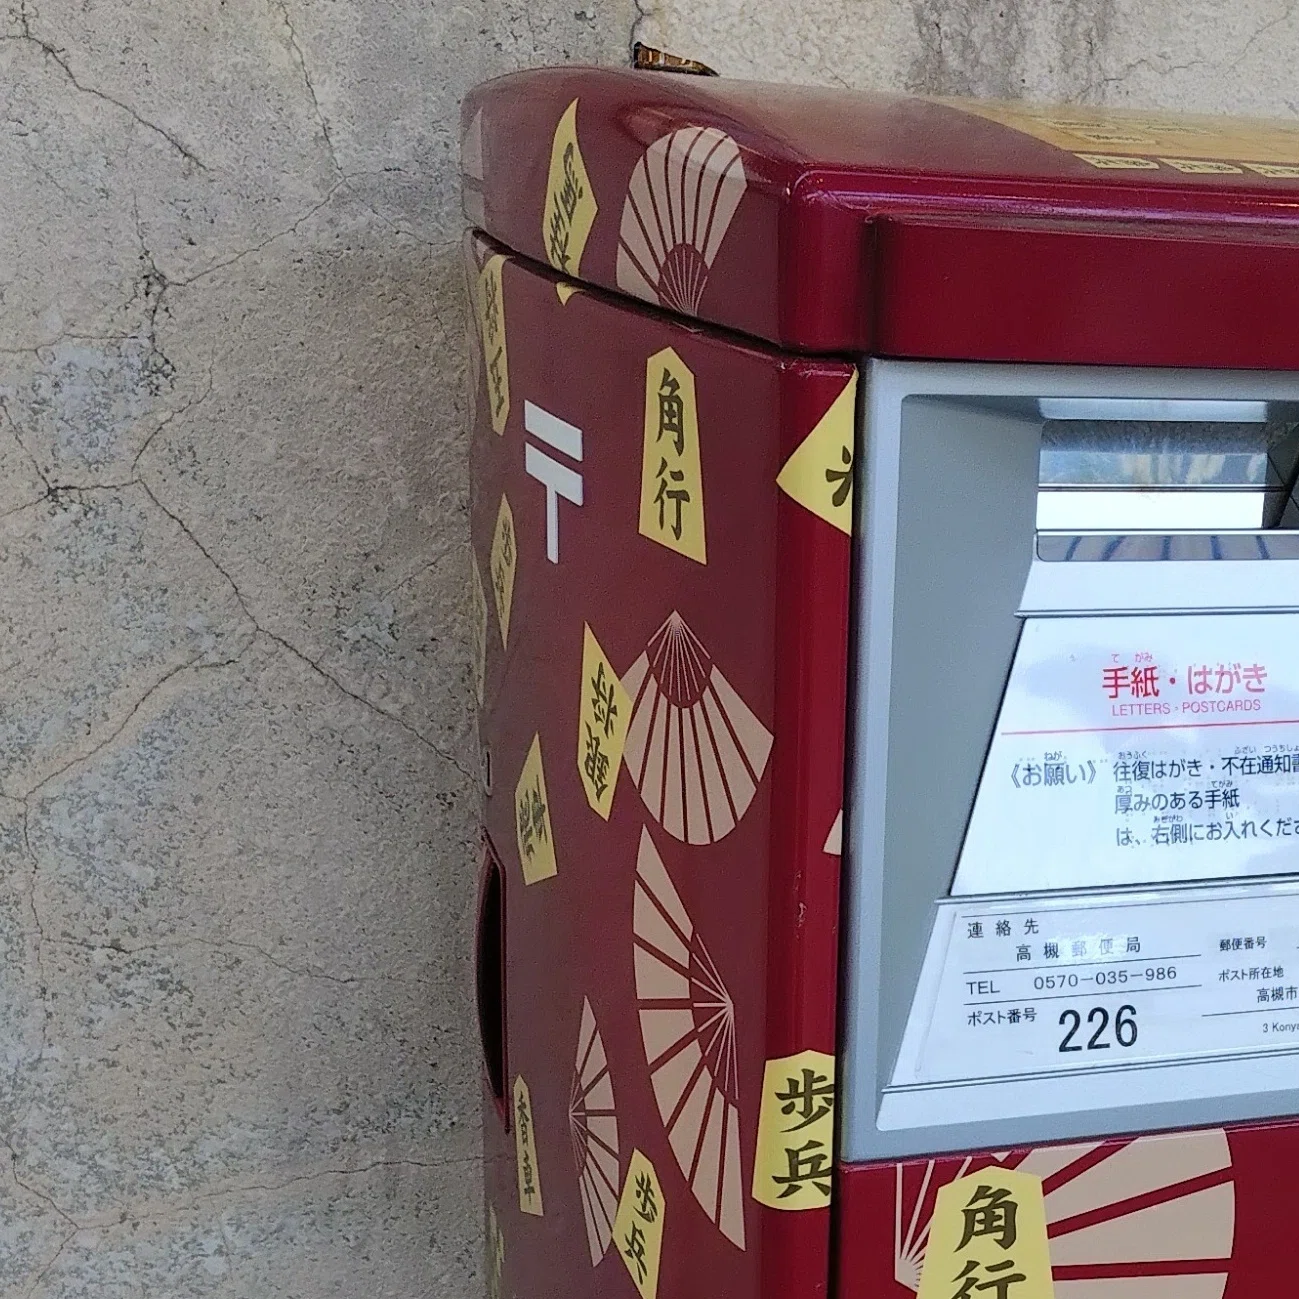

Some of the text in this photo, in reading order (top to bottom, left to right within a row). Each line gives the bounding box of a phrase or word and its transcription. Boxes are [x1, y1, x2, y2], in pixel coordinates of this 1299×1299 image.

[655, 366, 691, 542] 角行
[1102, 662, 1268, 699] 手紙・はがき
[1112, 698, 1261, 717] LETTERS POSTCARDS
[585, 661, 618, 802] 銀将
[1115, 788, 1240, 814] 厚みのある手紙
[967, 917, 1040, 939] 連絡先
[1016, 936, 1141, 962] 高槻郵便局
[1219, 936, 1267, 952] 郵便番号
[966, 966, 1177, 996] TEL 0570-035-986
[1219, 966, 1285, 982] ポスト所在地
[967, 1006, 1038, 1027] ポスト番号
[1058, 1003, 1138, 1053] 226
[771, 1068, 835, 1199] 歩兵
[624, 1171, 659, 1286] 歩兵
